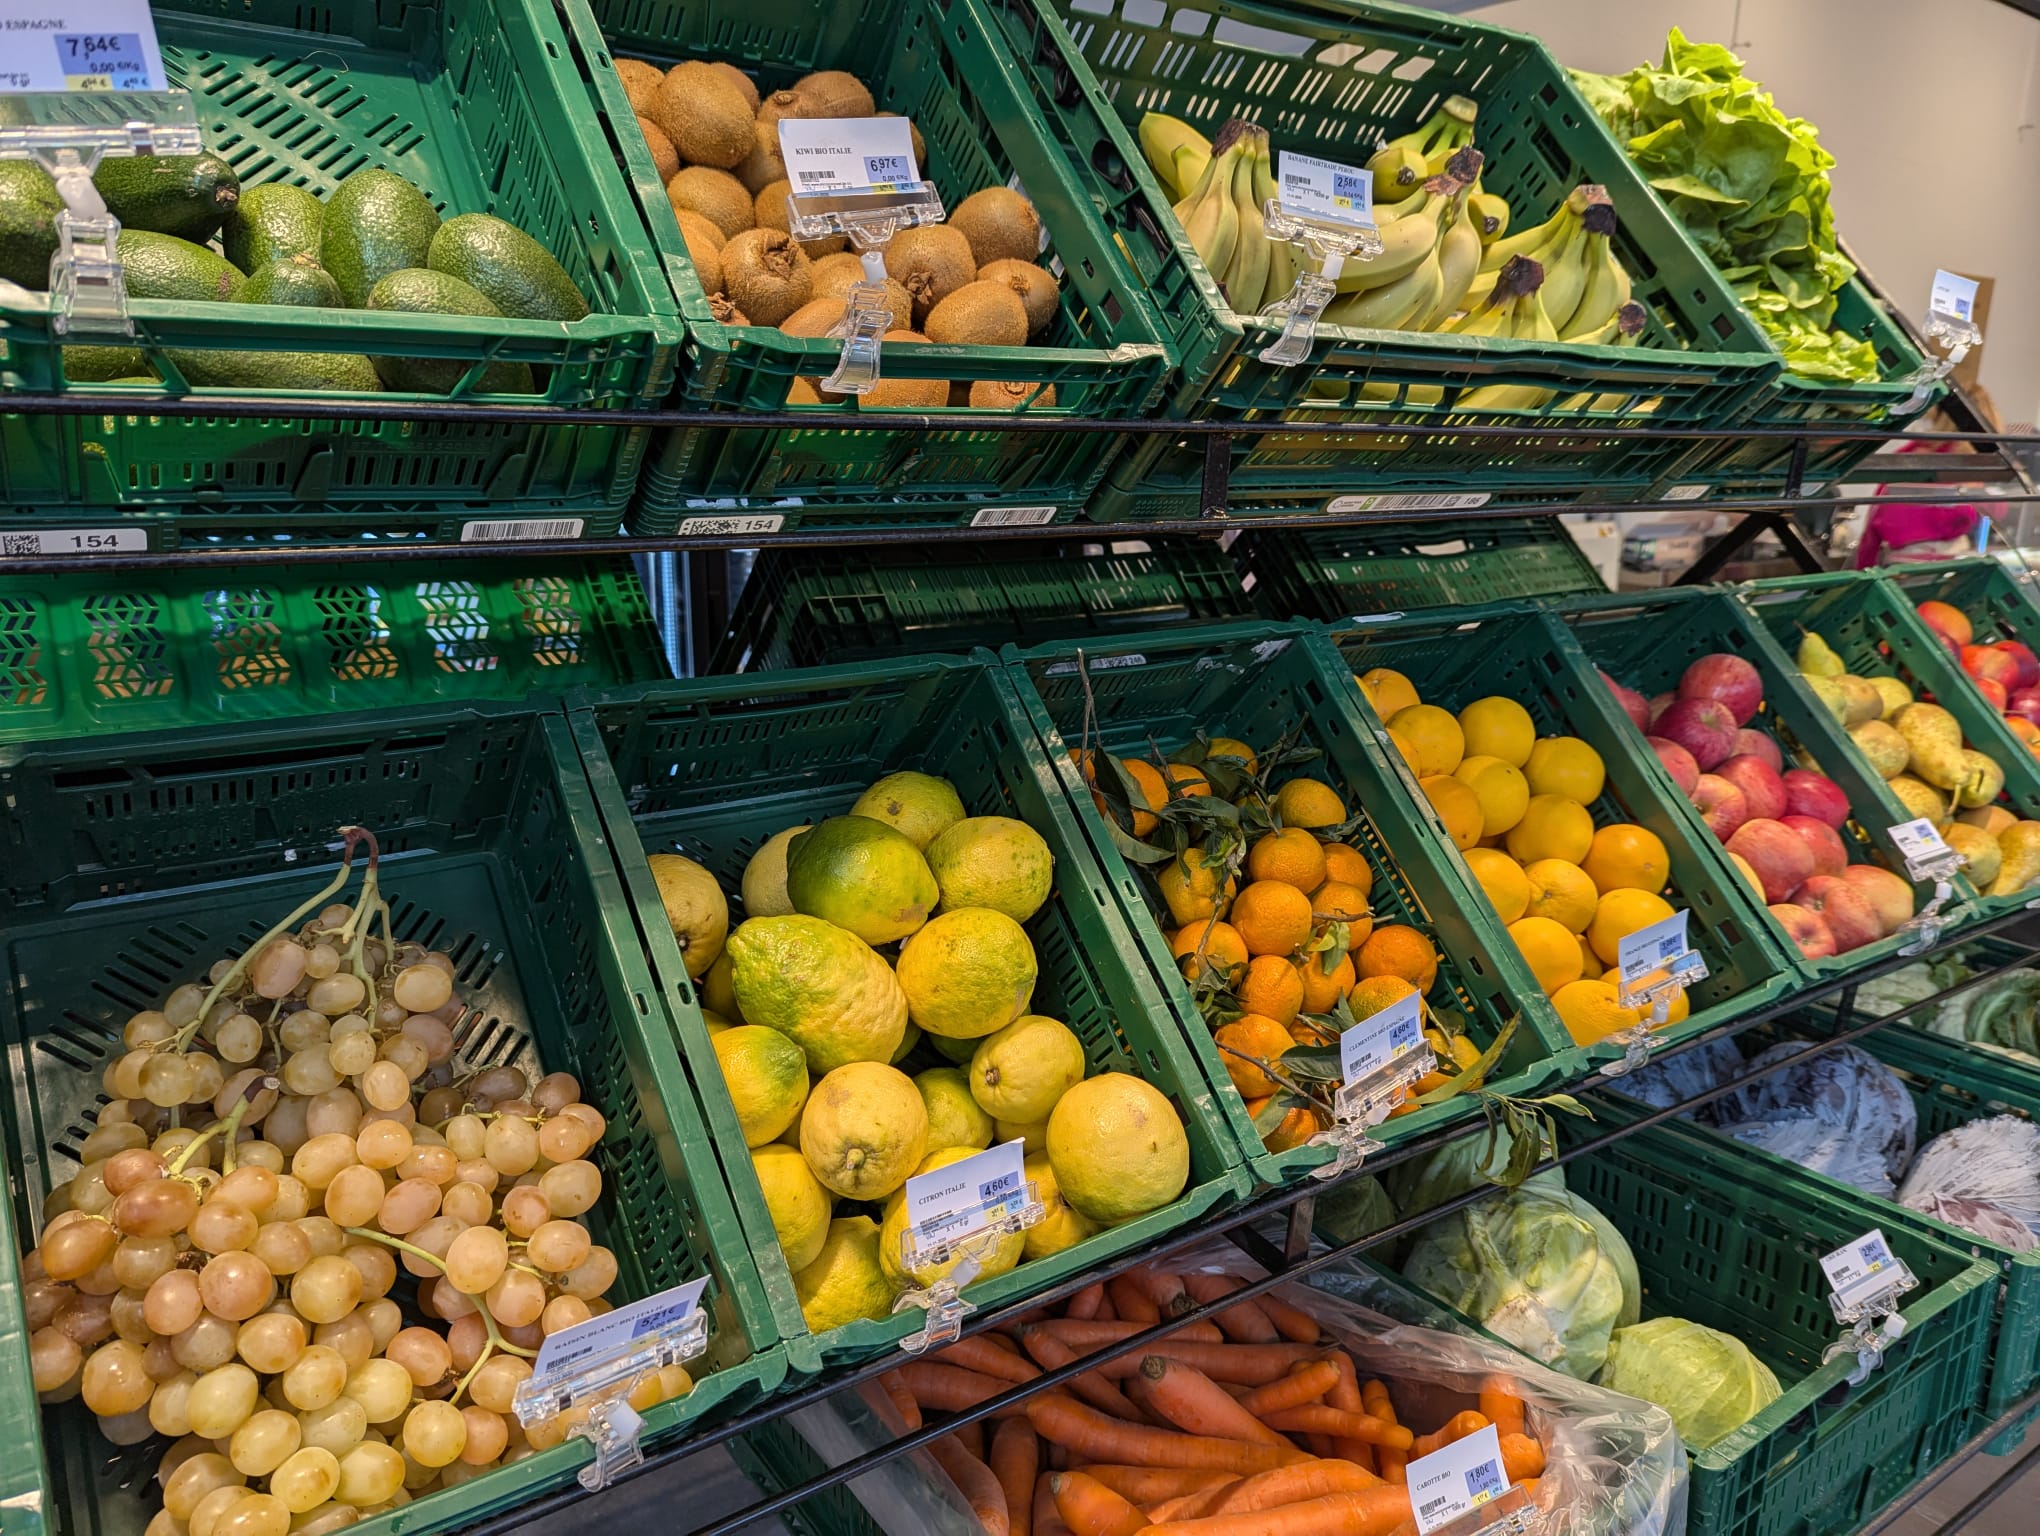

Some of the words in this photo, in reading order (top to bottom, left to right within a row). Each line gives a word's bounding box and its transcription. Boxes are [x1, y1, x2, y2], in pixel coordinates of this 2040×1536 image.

[795, 147, 813, 155] KIWI
[828, 147, 852, 155] ITALIE
[870, 158, 899, 174] 6,97€
[745, 520, 774, 531] 154
[70, 535, 119, 548] 154
[1392, 1021, 1410, 1039] 4,60€
[918, 1188, 944, 1205] CITRON
[945, 1182, 967, 1197] ITALIE
[984, 1176, 1009, 1197] 4,60€
[641, 1306, 676, 1328] 5,21€
[554, 1334, 586, 1350] RAISIN
[587, 1321, 618, 1339] BLANC
[1470, 1463, 1490, 1483] 1,80€
[1416, 1475, 1441, 1491] CAROTTE
